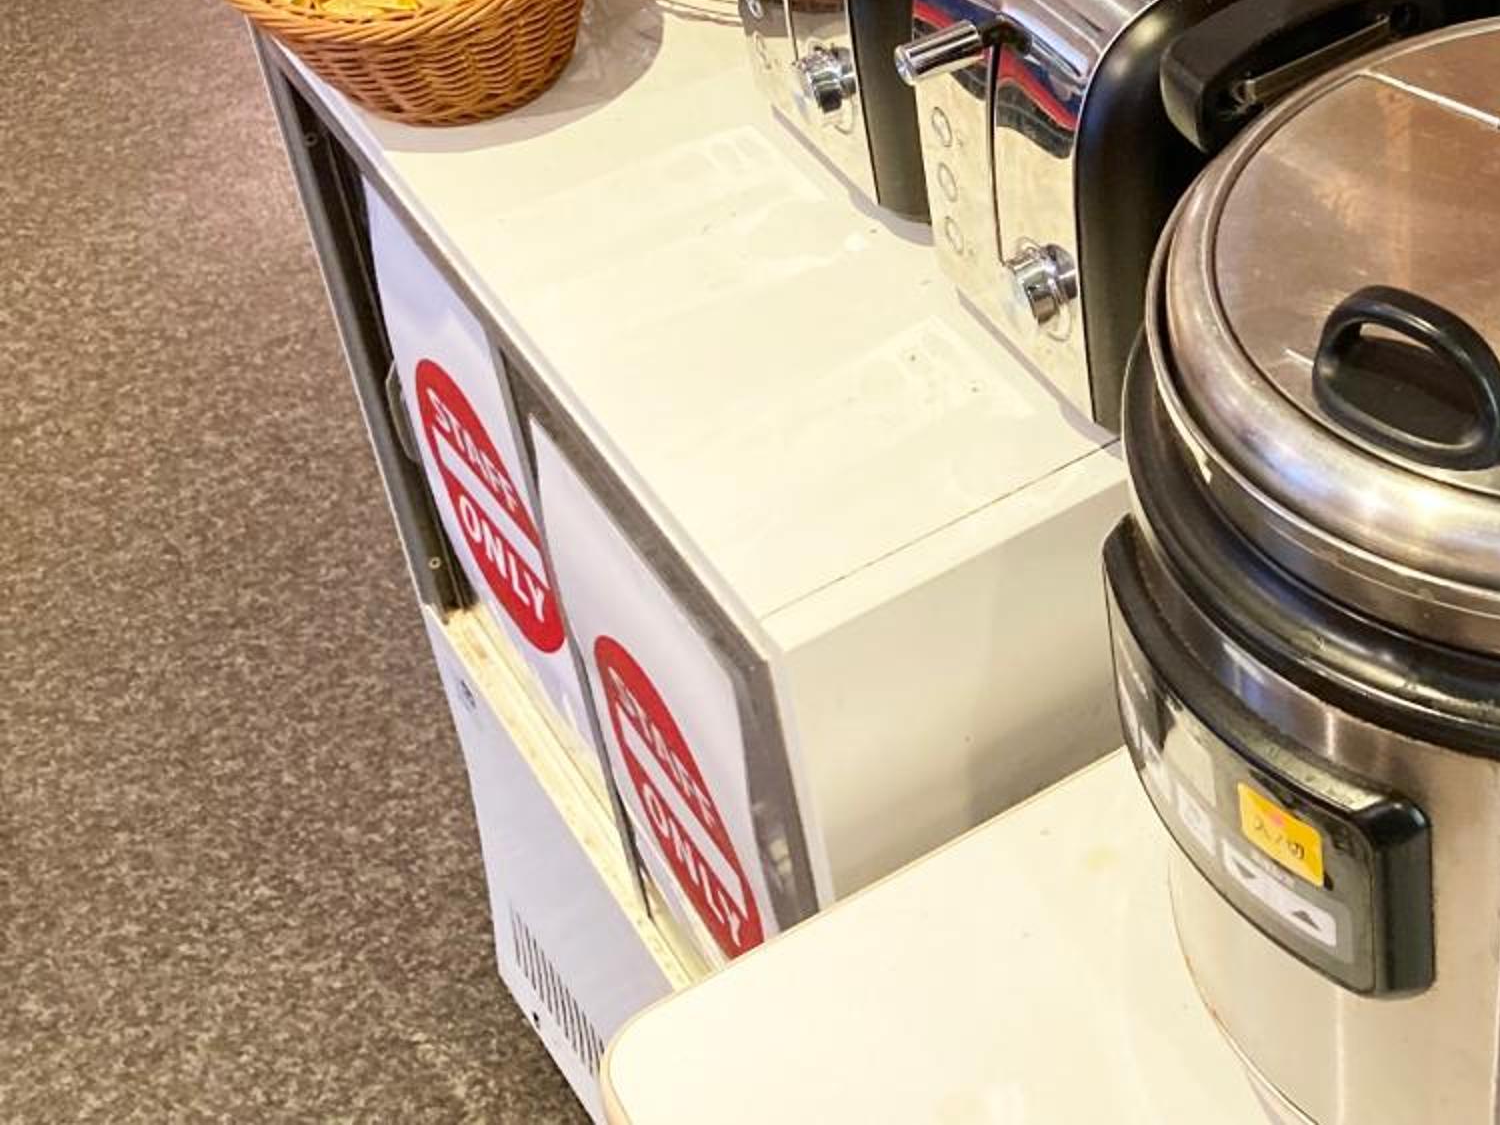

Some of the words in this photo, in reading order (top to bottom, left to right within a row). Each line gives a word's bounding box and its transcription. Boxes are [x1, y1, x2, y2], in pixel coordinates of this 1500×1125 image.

[426, 387, 518, 513] STAFF
[458, 494, 546, 623] ONLY
[642, 781, 742, 949] ONLY
